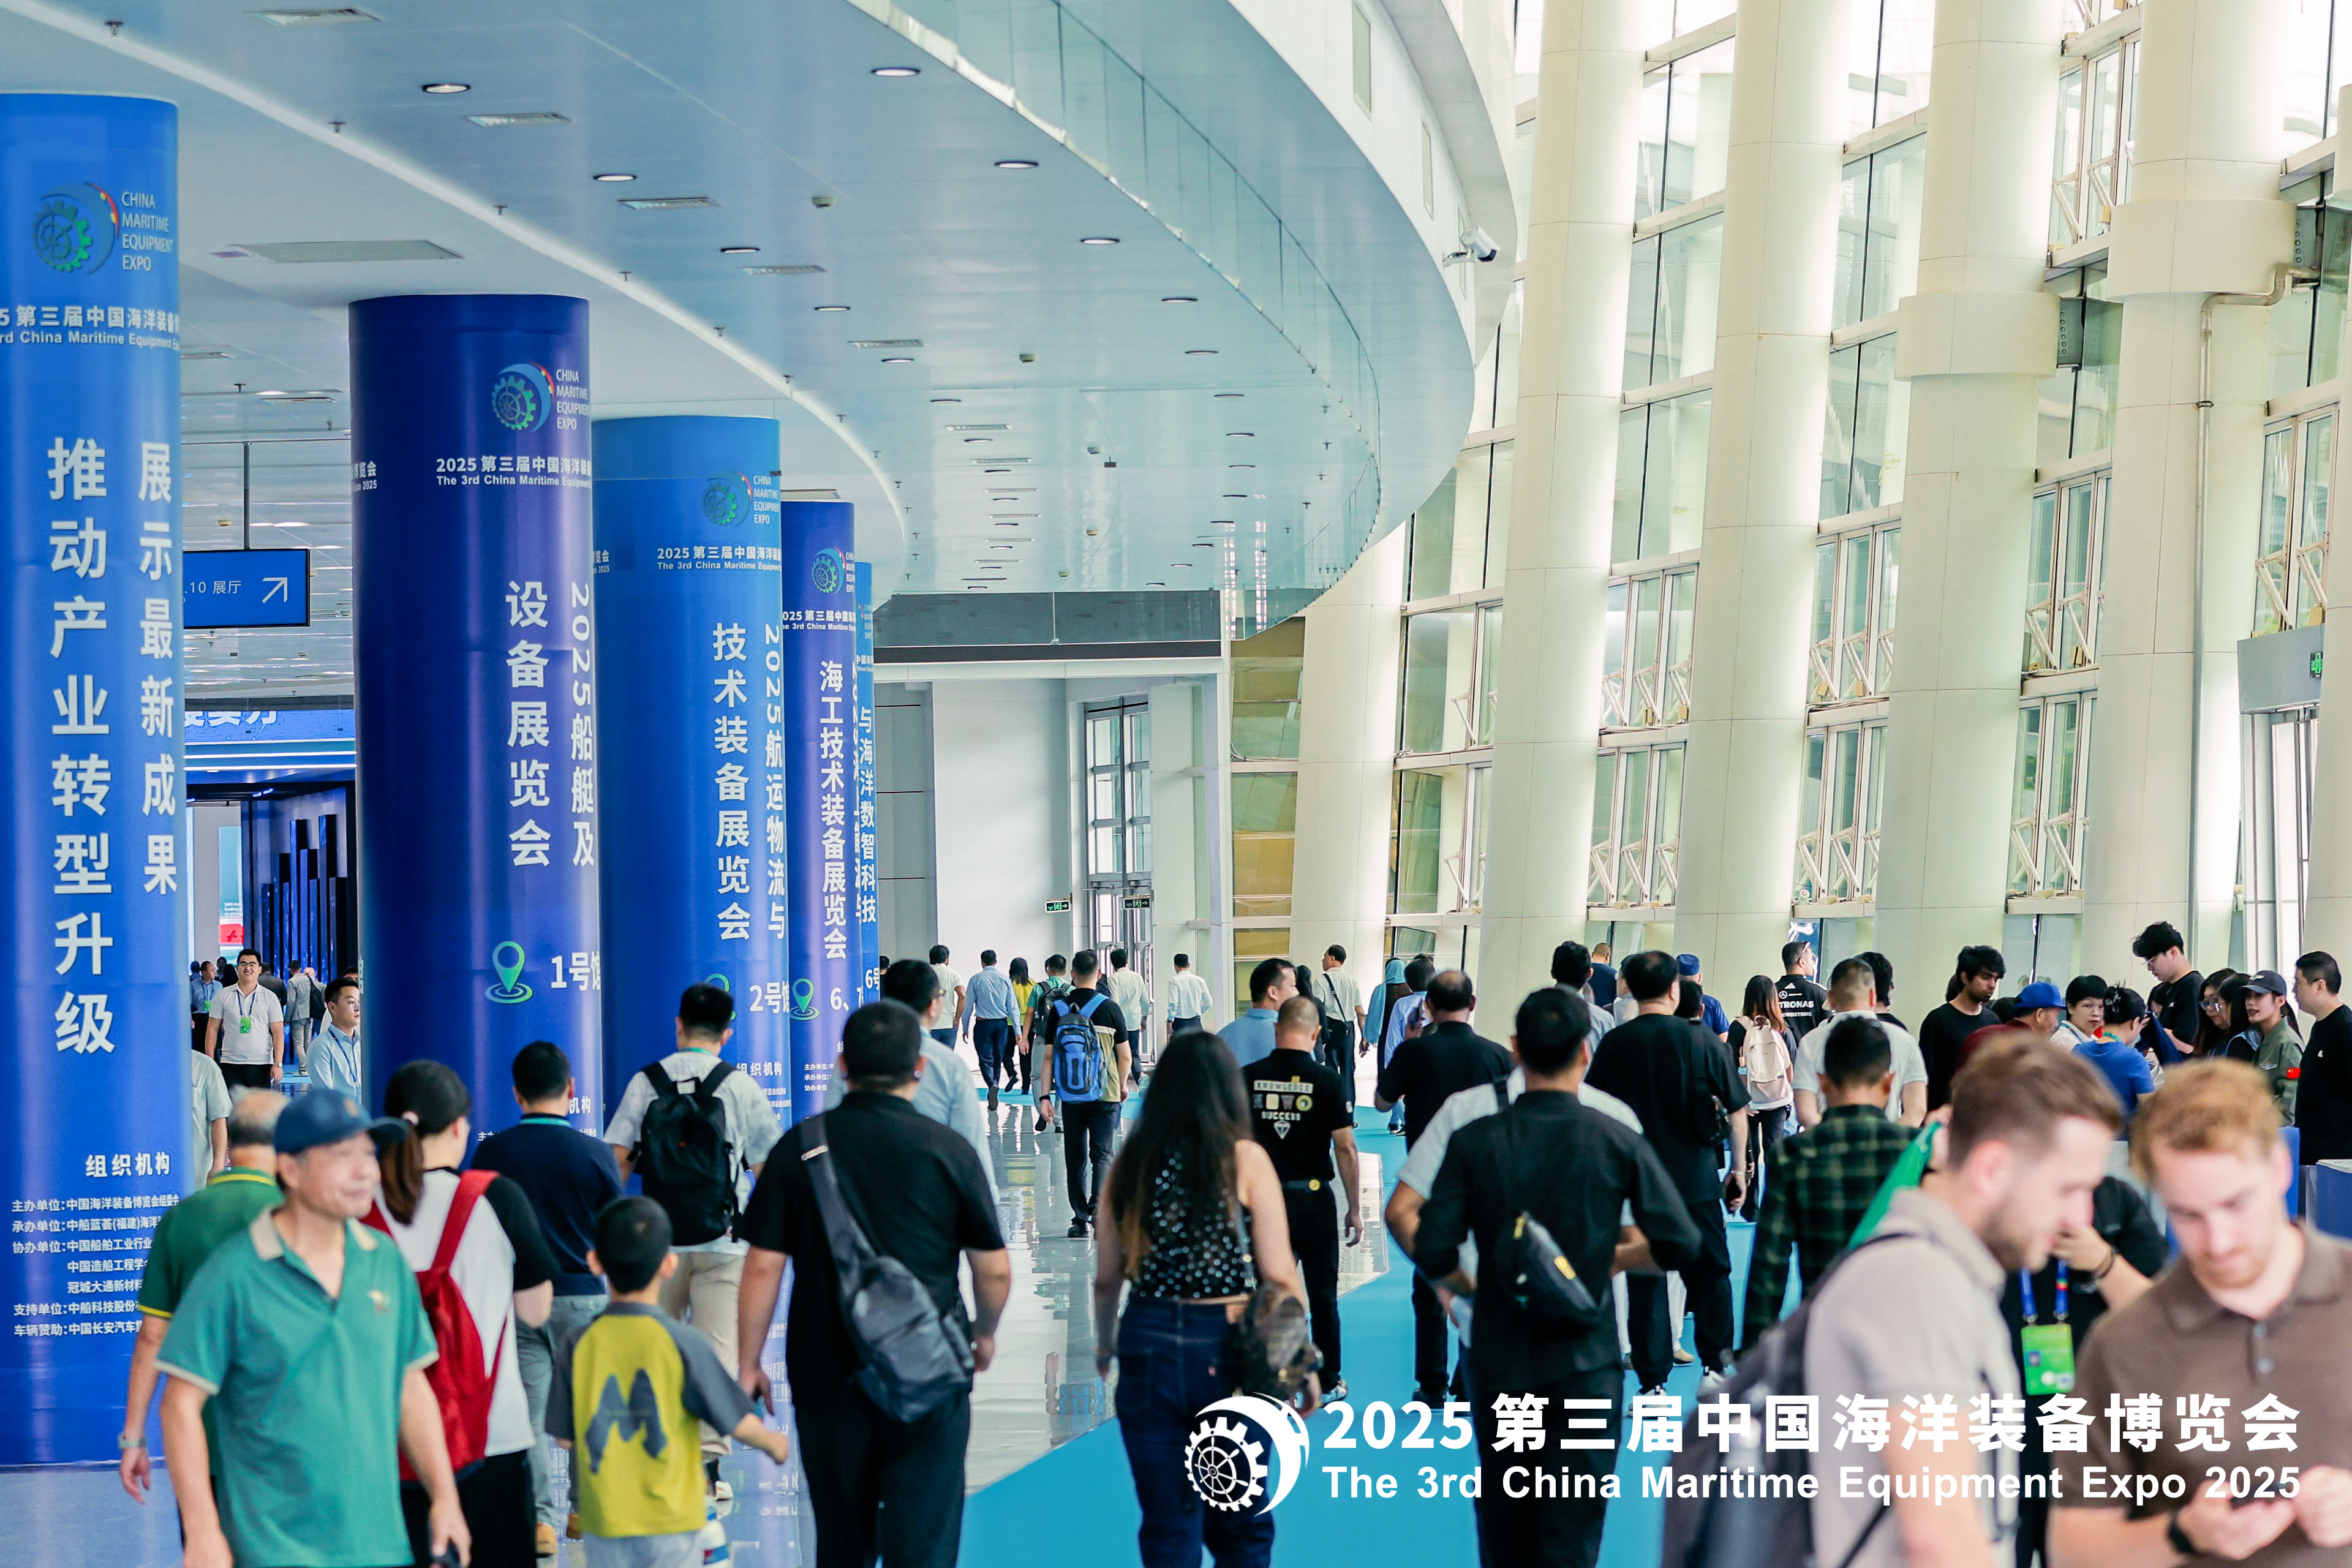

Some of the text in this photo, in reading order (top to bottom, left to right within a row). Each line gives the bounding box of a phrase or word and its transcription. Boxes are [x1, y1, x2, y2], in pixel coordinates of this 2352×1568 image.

[122, 191, 156, 209] CHINA
[123, 213, 169, 232] MARITIME
[123, 235, 173, 254] EQUIPMENT
[123, 255, 152, 272] EXPO
[20, 331, 62, 344] China
[68, 331, 125, 345] Maritime
[556, 369, 579, 383] CHINA
[556, 385, 588, 400] MARITIME
[557, 417, 578, 431] EXPO
[436, 457, 477, 472] 2025
[363, 480, 377, 491] 2025
[436, 475, 457, 486] The
[461, 475, 480, 485] 3rd
[484, 474, 516, 485] China
[519, 475, 559, 486] Maritime
[753, 475, 772, 486] CHINA
[754, 514, 770, 524] EXPO
[657, 547, 690, 559] 2025
[657, 562, 674, 570] The
[677, 561, 693, 570] 3rd
[695, 560, 721, 570] China
[724, 560, 756, 570] Maritime
[213, 580, 242, 595] 展厅
[138, 442, 178, 895] 展示最新成果
[505, 580, 551, 867] 设备展览会
[47, 437, 115, 1054] 推动产业转型升级
[712, 622, 752, 941] 技术装备展览会
[819, 660, 847, 960] 海工技术装备展览会
[859, 706, 876, 923] 与海洋数智科技
[736, 1061, 782, 1076] 组织机构
[1261, 1110, 1301, 1121] SUCCESS
[85, 1152, 170, 1178] 组织机构
